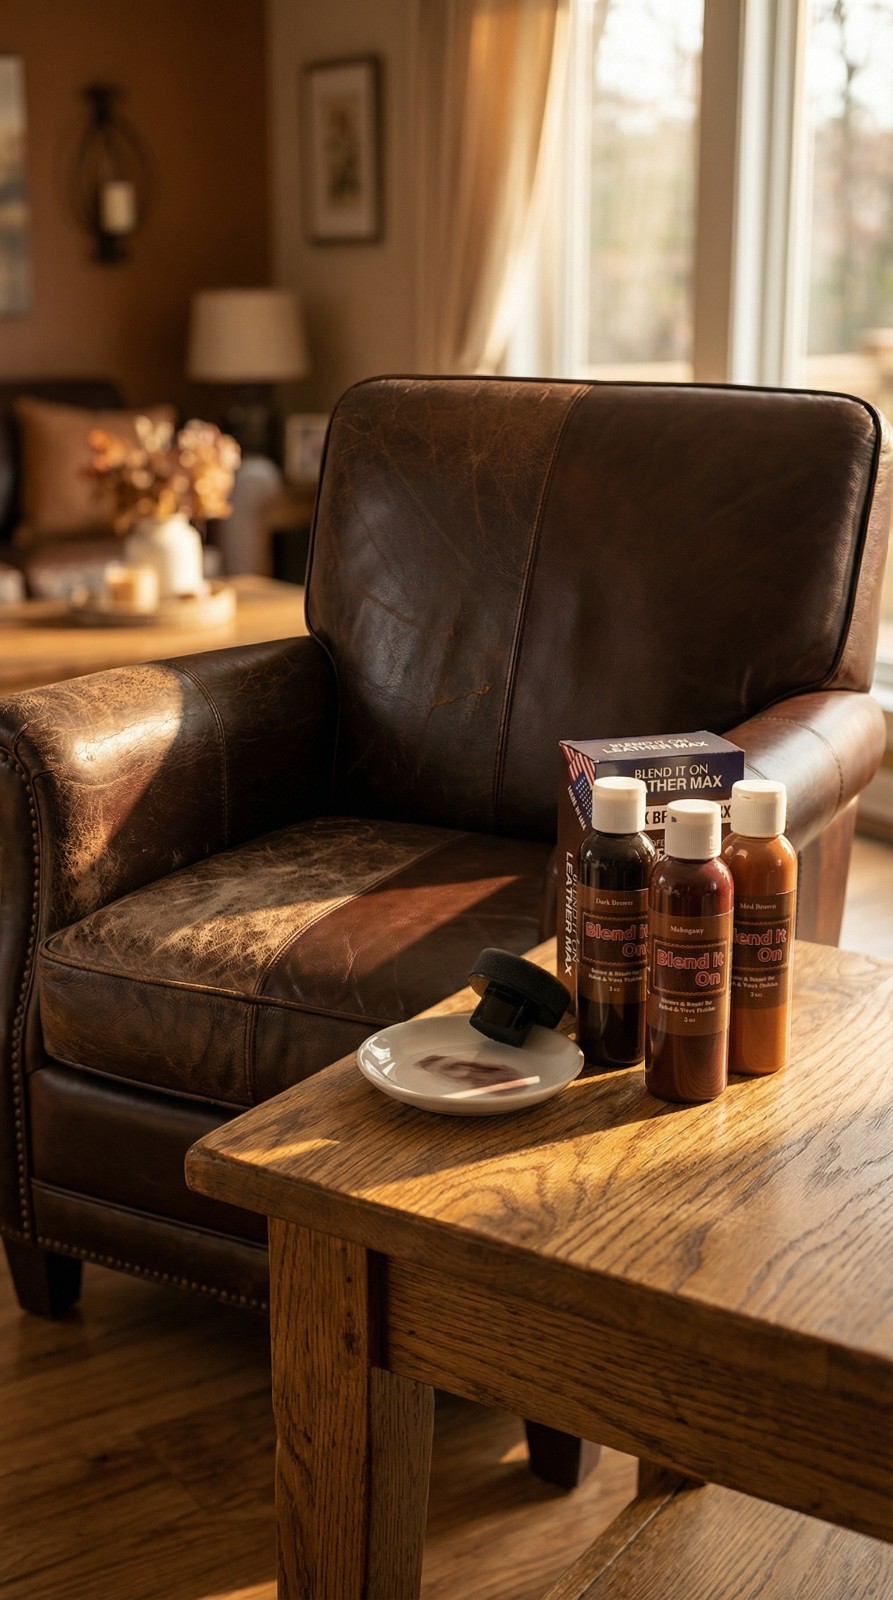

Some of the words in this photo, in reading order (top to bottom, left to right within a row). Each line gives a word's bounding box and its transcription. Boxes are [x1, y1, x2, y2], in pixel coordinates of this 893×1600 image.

[602, 743, 672, 754] LEATHER
[634, 767, 672, 780] BLEND
[676, 766, 686, 776] IT
[690, 764, 708, 775] ON
[648, 778, 686, 792] THER
[690, 775, 722, 790] MAX
[565, 851, 574, 934] LEATHER
[585, 921, 636, 941] Blend
[734, 928, 772, 946] lend
[564, 936, 572, 976] MAX
[622, 942, 646, 958] On
[758, 948, 782, 962] On
[657, 949, 710, 970] Blend
[694, 971, 720, 986] On
